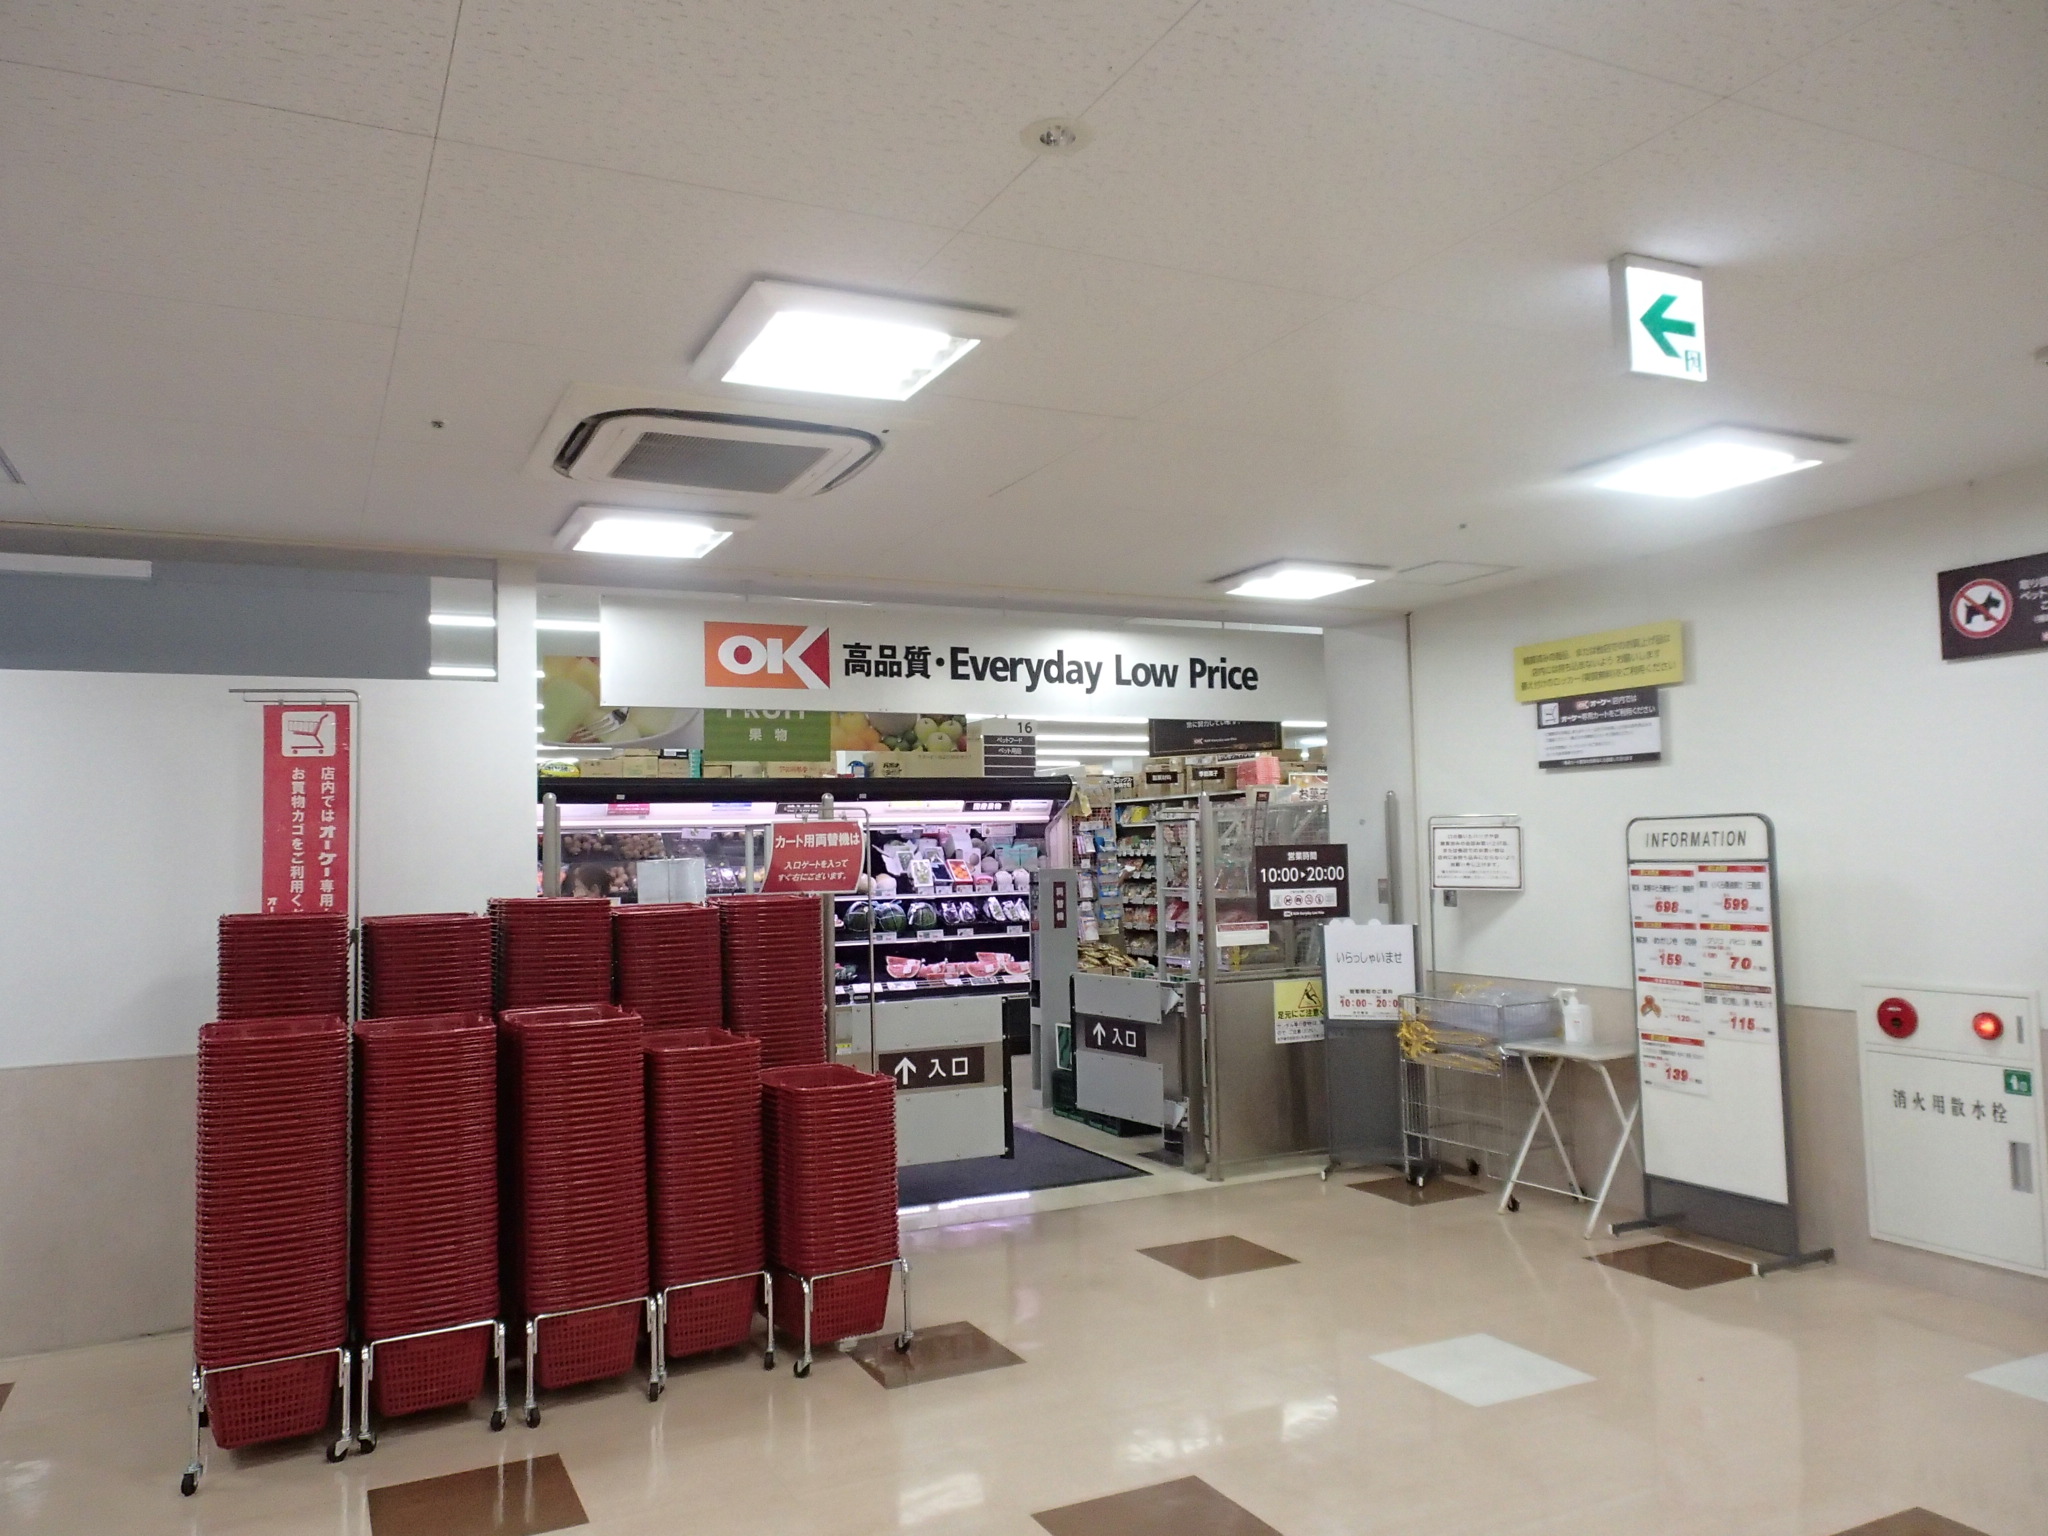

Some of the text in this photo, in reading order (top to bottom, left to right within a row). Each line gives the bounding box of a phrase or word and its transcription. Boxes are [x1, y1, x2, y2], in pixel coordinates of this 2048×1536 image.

[718, 626, 830, 689] OK
[1115, 654, 1179, 687] Low
[1189, 657, 1259, 691] Price
[749, 728, 788, 741] 果物
[1018, 722, 1033, 734] 16
[998, 747, 1023, 755] ペット用品
[290, 767, 307, 912] お買物カゴをご利用く
[317, 766, 337, 912] 店内ではオーケー専用
[775, 832, 860, 849] カート用両替機は
[1646, 831, 1747, 848] INFORMATION
[784, 859, 849, 870] 入口ゲートを入って
[1287, 851, 1318, 861] 営業時間
[1260, 866, 1345, 883] 10:00 20:00
[1336, 951, 1403, 964] いらっしゃいませ
[1376, 998, 1399, 1007] 20:0
[1112, 1028, 1137, 1048] 入口
[928, 1056, 969, 1079] 入口
[1893, 1088, 2008, 1124] 消火用散水栓
